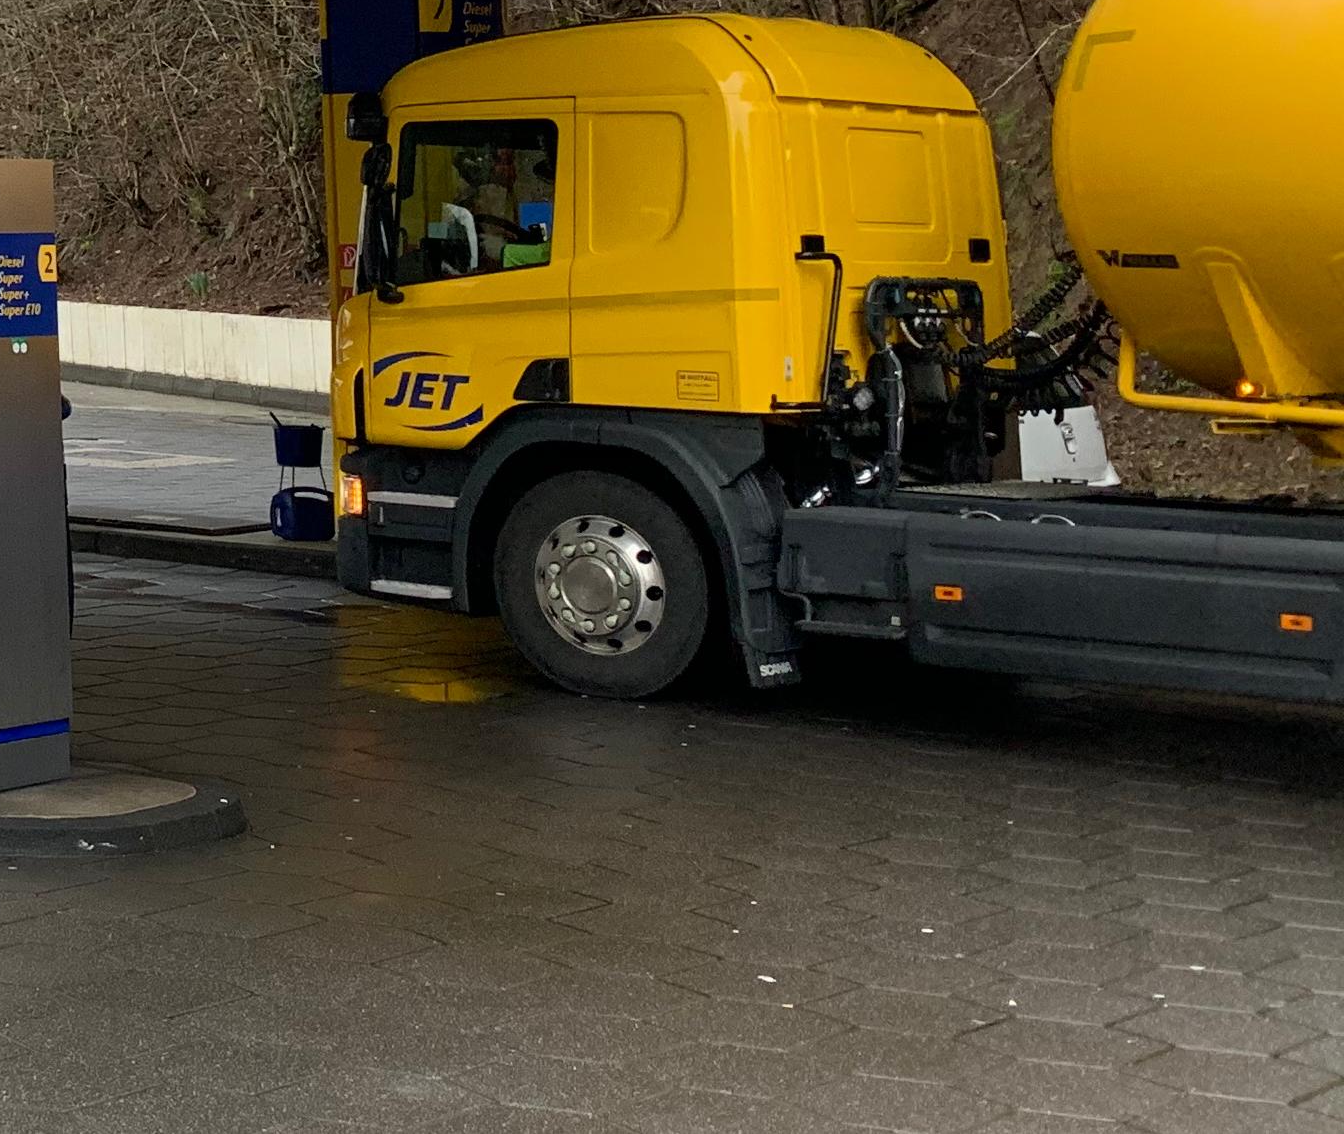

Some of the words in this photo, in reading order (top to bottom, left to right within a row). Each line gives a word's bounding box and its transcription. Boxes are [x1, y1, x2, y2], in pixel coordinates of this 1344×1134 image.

[463, 1, 493, 15] Diesel
[463, 19, 491, 37] Super
[44, 251, 54, 274] 2
[25, 303, 42, 316] E10
[383, 371, 470, 411] JET
[759, 661, 793, 677] SCANIA
